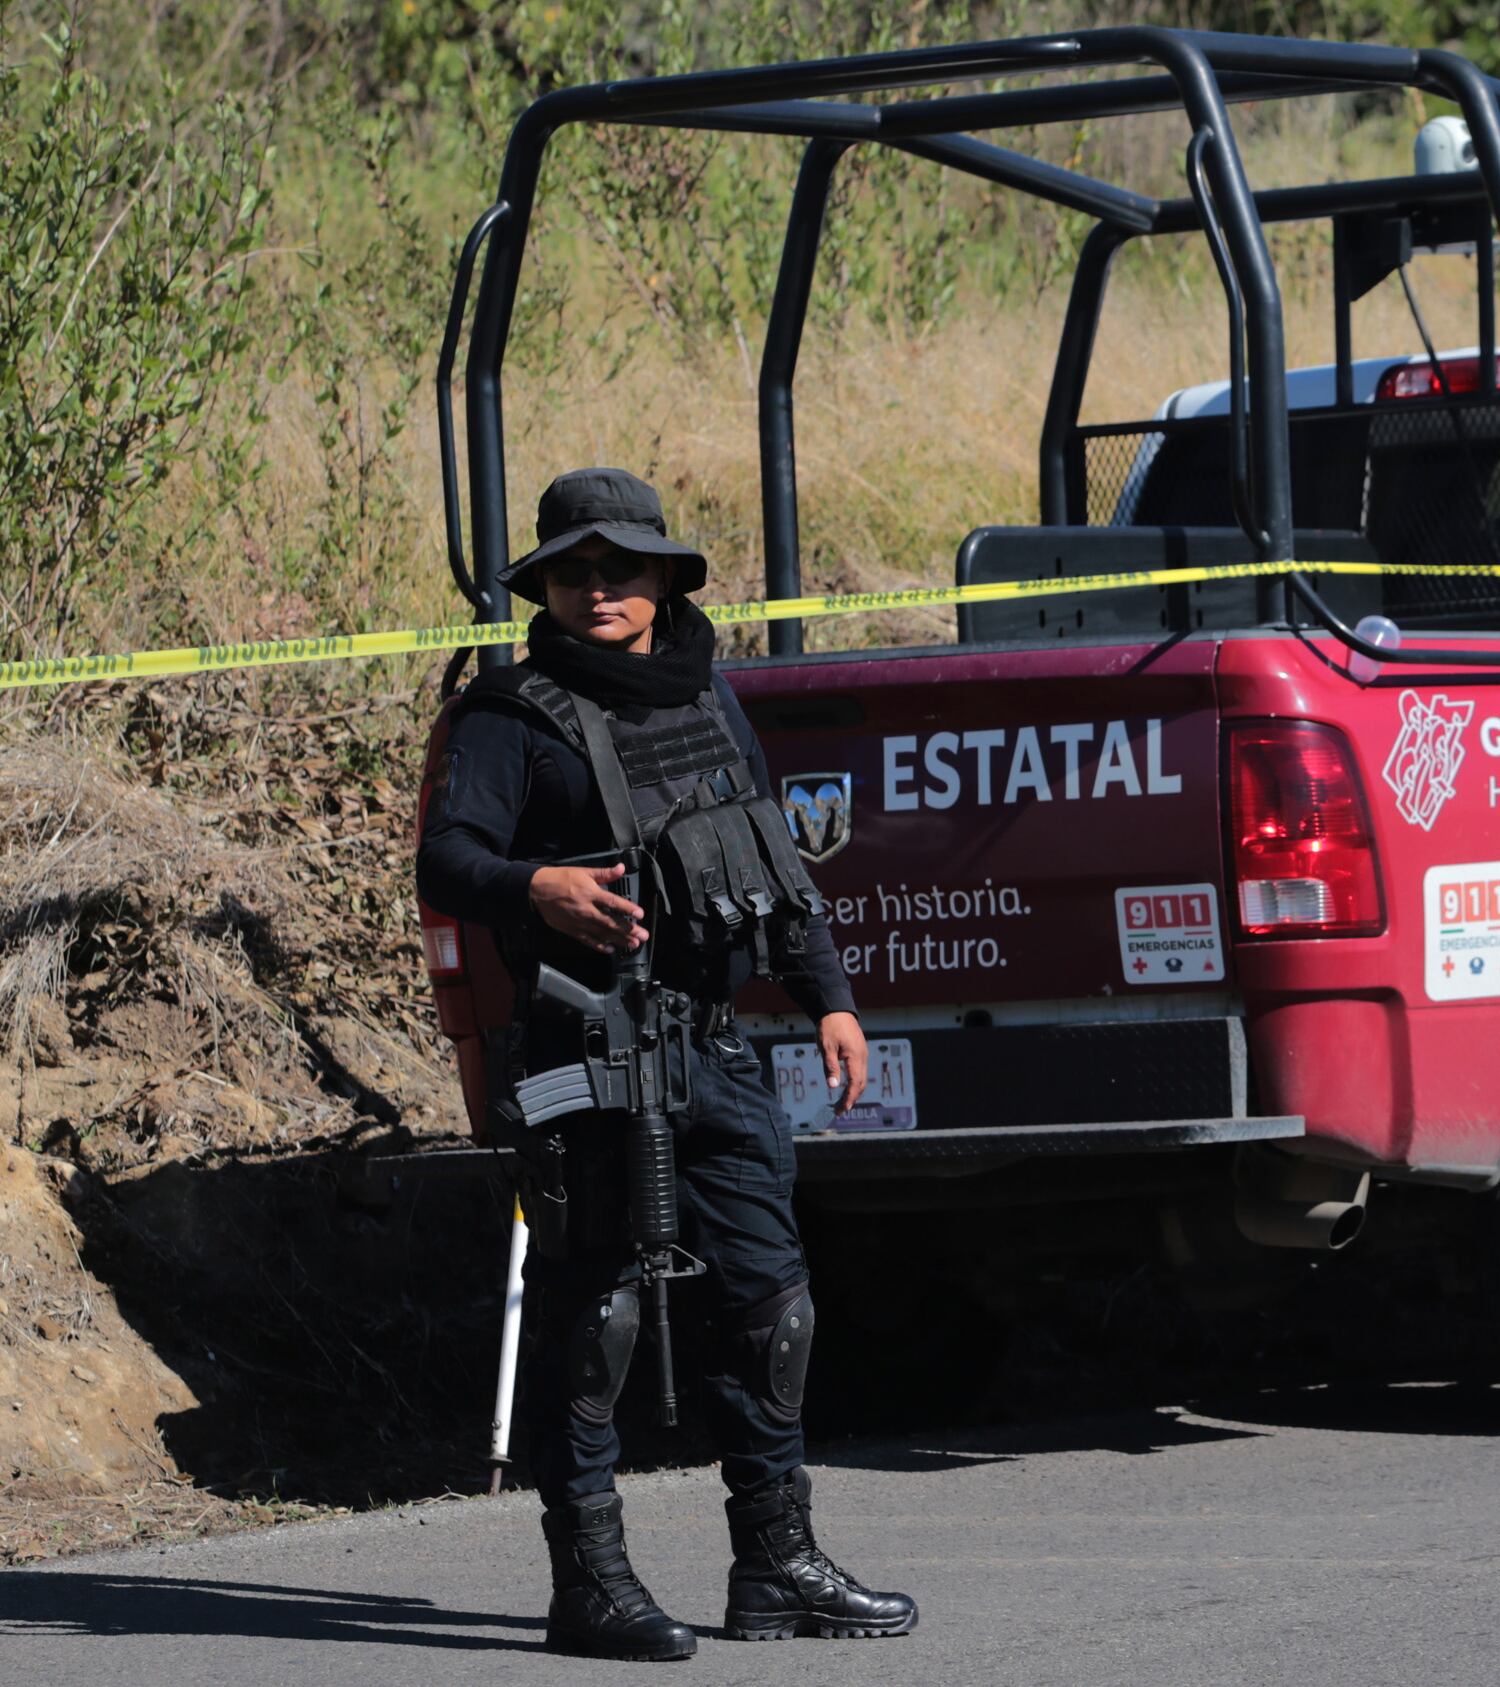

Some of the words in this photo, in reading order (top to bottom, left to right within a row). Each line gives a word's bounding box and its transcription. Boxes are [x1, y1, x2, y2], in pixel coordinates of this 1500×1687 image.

[883, 718, 1182, 812] ESTATAL
[820, 895, 868, 925] cer
[877, 878, 1031, 923] historia.
[1130, 898, 1203, 926] 911
[886, 930, 1007, 983] futuro.
[1128, 939, 1215, 952] EMERGENCIAS
[836, 1107, 878, 1120] UEBLA
